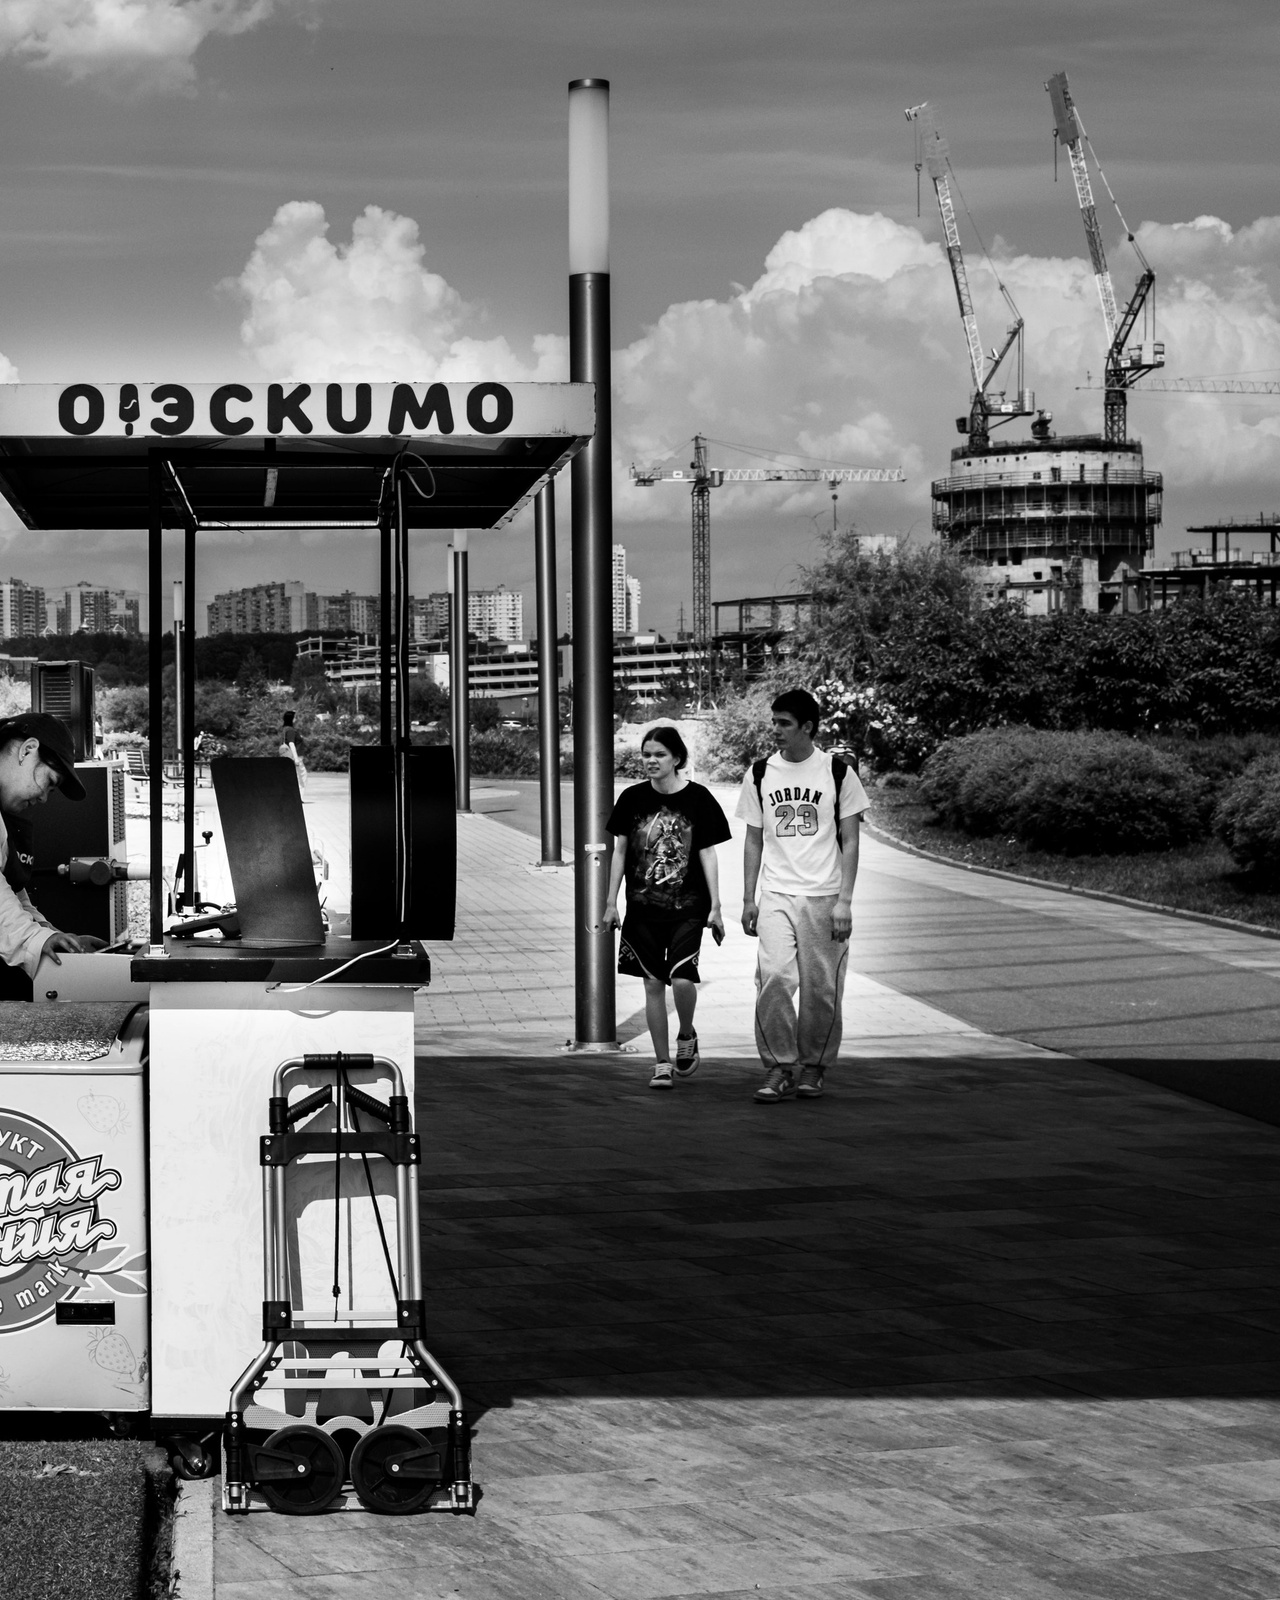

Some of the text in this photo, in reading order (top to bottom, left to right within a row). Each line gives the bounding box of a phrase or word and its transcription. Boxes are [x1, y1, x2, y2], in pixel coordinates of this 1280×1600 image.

[768, 786, 823, 807] JORDAN
[775, 803, 819, 837] 23
[16, 1260, 69, 1309] mark
